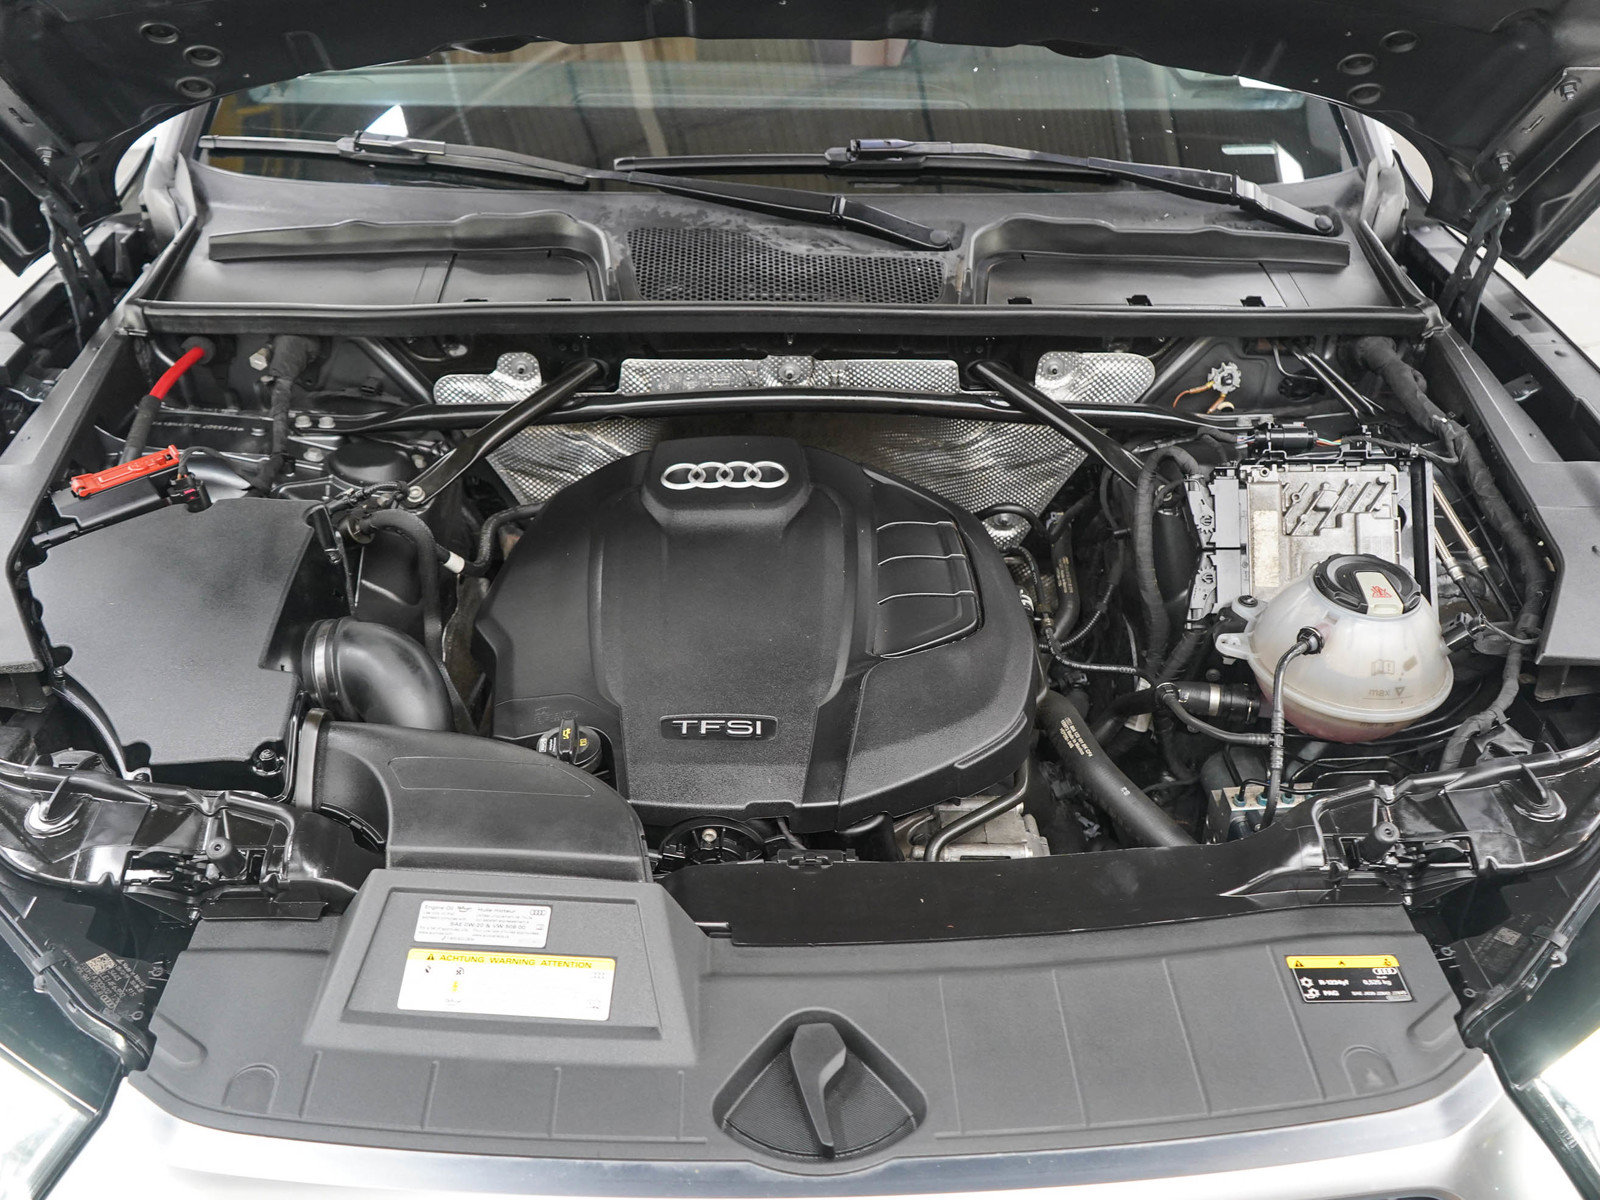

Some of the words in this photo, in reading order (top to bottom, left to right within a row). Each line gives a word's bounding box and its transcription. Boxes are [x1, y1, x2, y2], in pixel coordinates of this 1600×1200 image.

[1368, 688, 1390, 697] max
[672, 720, 762, 735] TFSI
[439, 955, 485, 964] ACHTUNG
[490, 957, 535, 966] WARNING
[540, 960, 592, 969] ATTENTION
